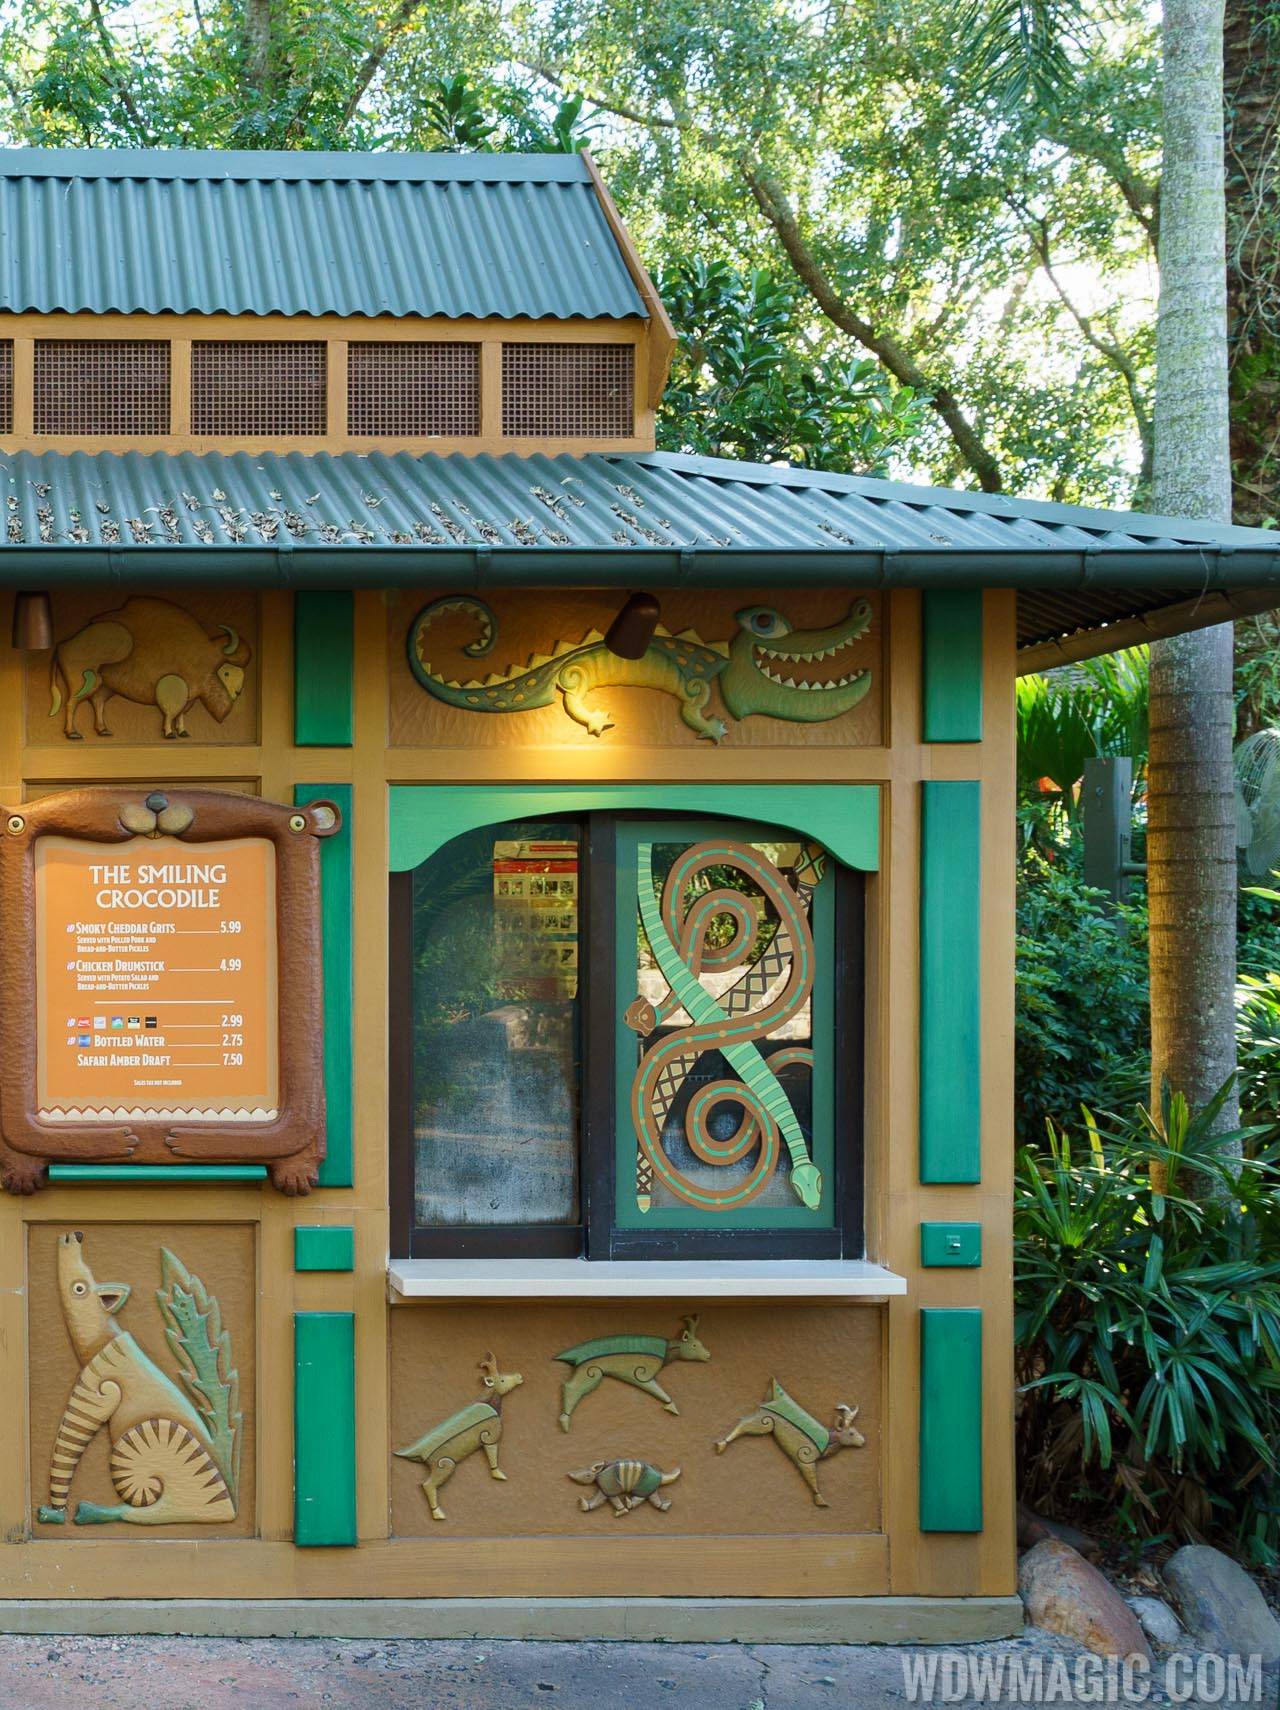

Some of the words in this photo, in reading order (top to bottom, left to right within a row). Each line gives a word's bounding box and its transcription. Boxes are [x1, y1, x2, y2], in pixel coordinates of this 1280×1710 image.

[88, 864, 131, 884] THE
[137, 864, 227, 884] SMILING
[96, 889, 220, 908] CROCODILE
[221, 921, 241, 933] 5.99
[76, 960, 113, 972] CHICKEN
[115, 959, 165, 972] DRUMSTICK
[220, 959, 241, 971] 4.99
[221, 1014, 243, 1028] 2.99
[94, 1034, 133, 1047] BOTTLED
[134, 1034, 165, 1047] WATER
[222, 1033, 243, 1047] 2.75
[223, 1053, 243, 1066] 7.50
